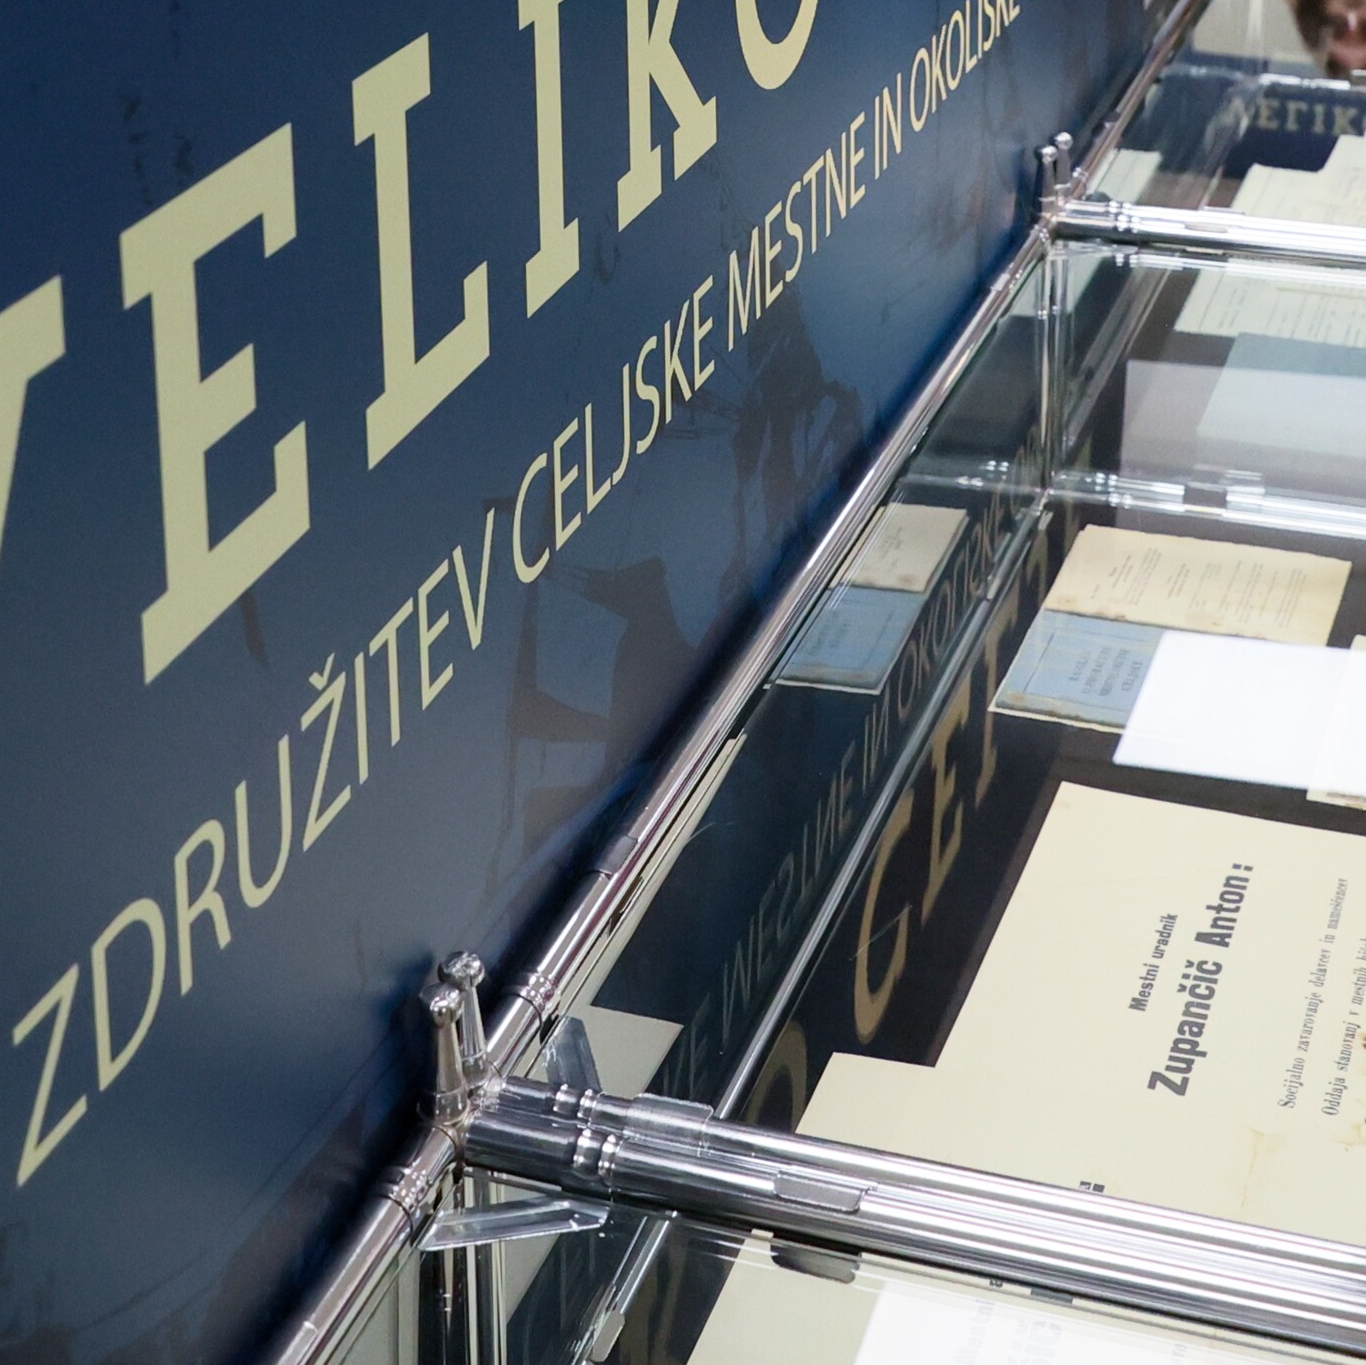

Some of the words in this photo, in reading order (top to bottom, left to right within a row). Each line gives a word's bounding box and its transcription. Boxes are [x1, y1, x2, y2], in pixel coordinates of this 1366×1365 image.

[14, 511, 496, 1183] ZDRUŽITEV
[512, 278, 715, 584] CELJSKE
[727, 111, 866, 347] MESTNE
[873, 72, 903, 180] IN
[1128, 962, 1160, 1012] Mestni
[1151, 912, 1179, 960] uradnik
[1146, 958, 1224, 1097] Zupančič
[1277, 1057, 1307, 1110] Socijalno
[1297, 992, 1324, 1053] zavarovanje
[1323, 933, 1337, 945] in
[1334, 1020, 1362, 1071] stanovanj
[1347, 1009, 1361, 1017] v
[1321, 1077, 1348, 1116] Oddaja
